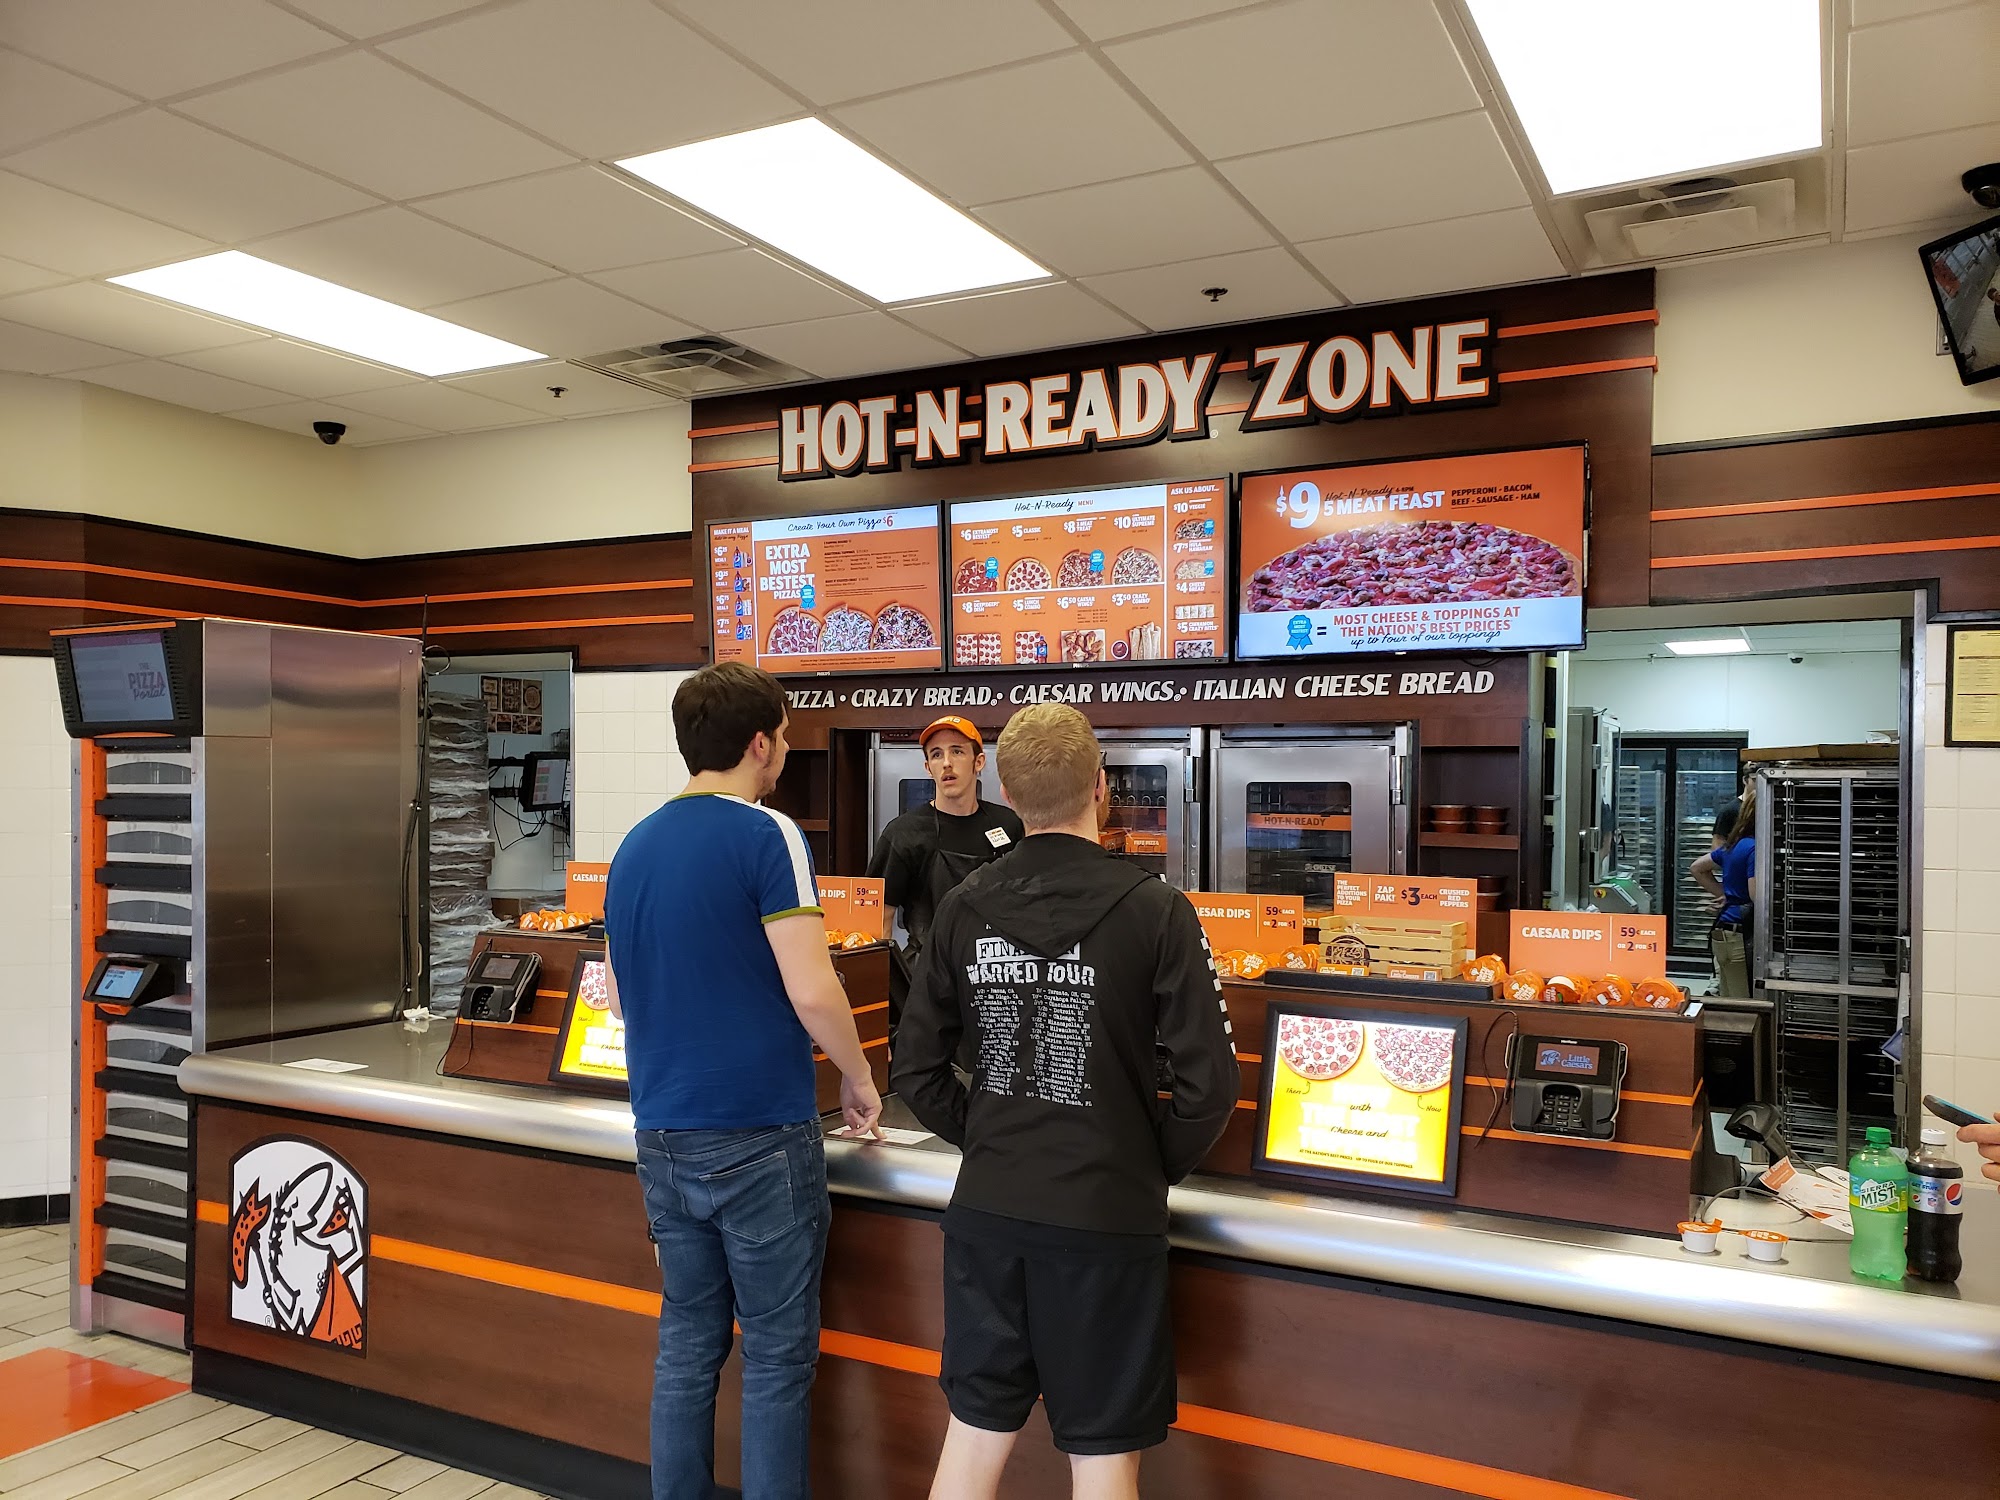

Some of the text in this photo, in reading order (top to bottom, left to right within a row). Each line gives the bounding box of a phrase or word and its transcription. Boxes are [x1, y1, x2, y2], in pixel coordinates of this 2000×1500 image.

[781, 318, 1489, 480] HOT-N-READY ZONE
[1452, 484, 1532, 497] PEPPERONI BACON
[1014, 498, 1074, 512] Hot-N-Ready
[1276, 481, 1321, 529] $9
[1324, 491, 1445, 516] 5 MEAT FEAST
[1451, 493, 1540, 506] BEEF SAUSAGE HAM
[1173, 502, 1188, 513] $10
[788, 515, 893, 532] Create Your Own Pizza $6
[1063, 521, 1076, 533] $8
[1114, 516, 1131, 529] $10
[961, 529, 972, 541] $6
[1012, 525, 1023, 538] $5
[765, 543, 810, 560] EXTRA
[769, 559, 807, 575] MOST
[760, 573, 815, 591] BESTEST
[1176, 582, 1188, 593] $4
[773, 589, 801, 600] PIZZAS
[962, 602, 973, 613] $8
[1013, 599, 1023, 611] $5
[1334, 606, 1520, 625] MOST CHEESE & TOPPINGS AT
[1177, 622, 1188, 633] $5
[1341, 620, 1511, 637] THE NATION'S BEST PRICES
[1351, 639, 1364, 649] up
[1381, 632, 1407, 643] four
[1411, 632, 1425, 642] of
[1448, 631, 1500, 643] toppings
[128, 671, 166, 689] PIZZA
[133, 685, 166, 701] Portal
[786, 670, 1494, 708] PIZZA CRAZY BREAD CAESAR WINGS ITALIAN CHEESE BREAD
[1264, 816, 1326, 827] HOT-N-READY
[572, 873, 598, 882] CAESAR
[828, 889, 846, 898] DIPS
[1377, 885, 1395, 894] ZAP
[1439, 888, 1469, 896] CRUSHED
[1374, 893, 1395, 902] PAK!
[1401, 887, 1421, 906] $3
[860, 899, 865, 907] 2
[872, 899, 878, 907] $1
[1440, 900, 1469, 908] PEPPERS
[1227, 908, 1251, 919] DIPS
[1271, 919, 1277, 928] 2
[1288, 920, 1296, 929] $1
[1522, 927, 1602, 941] CAESAR DIPS
[1627, 941, 1634, 951] 2
[1648, 942, 1657, 952] $1
[966, 962, 1095, 986] WARPED TOUR
[1568, 1054, 1591, 1063] Little
[1561, 1060, 1593, 1070] Caesars
[1350, 1104, 1371, 1112] with
[1426, 1105, 1441, 1113] Now
[1331, 1126, 1389, 1138] Cheese and
[1861, 1181, 1894, 1194] SIERRA
[1861, 1186, 1896, 1207] MIST
